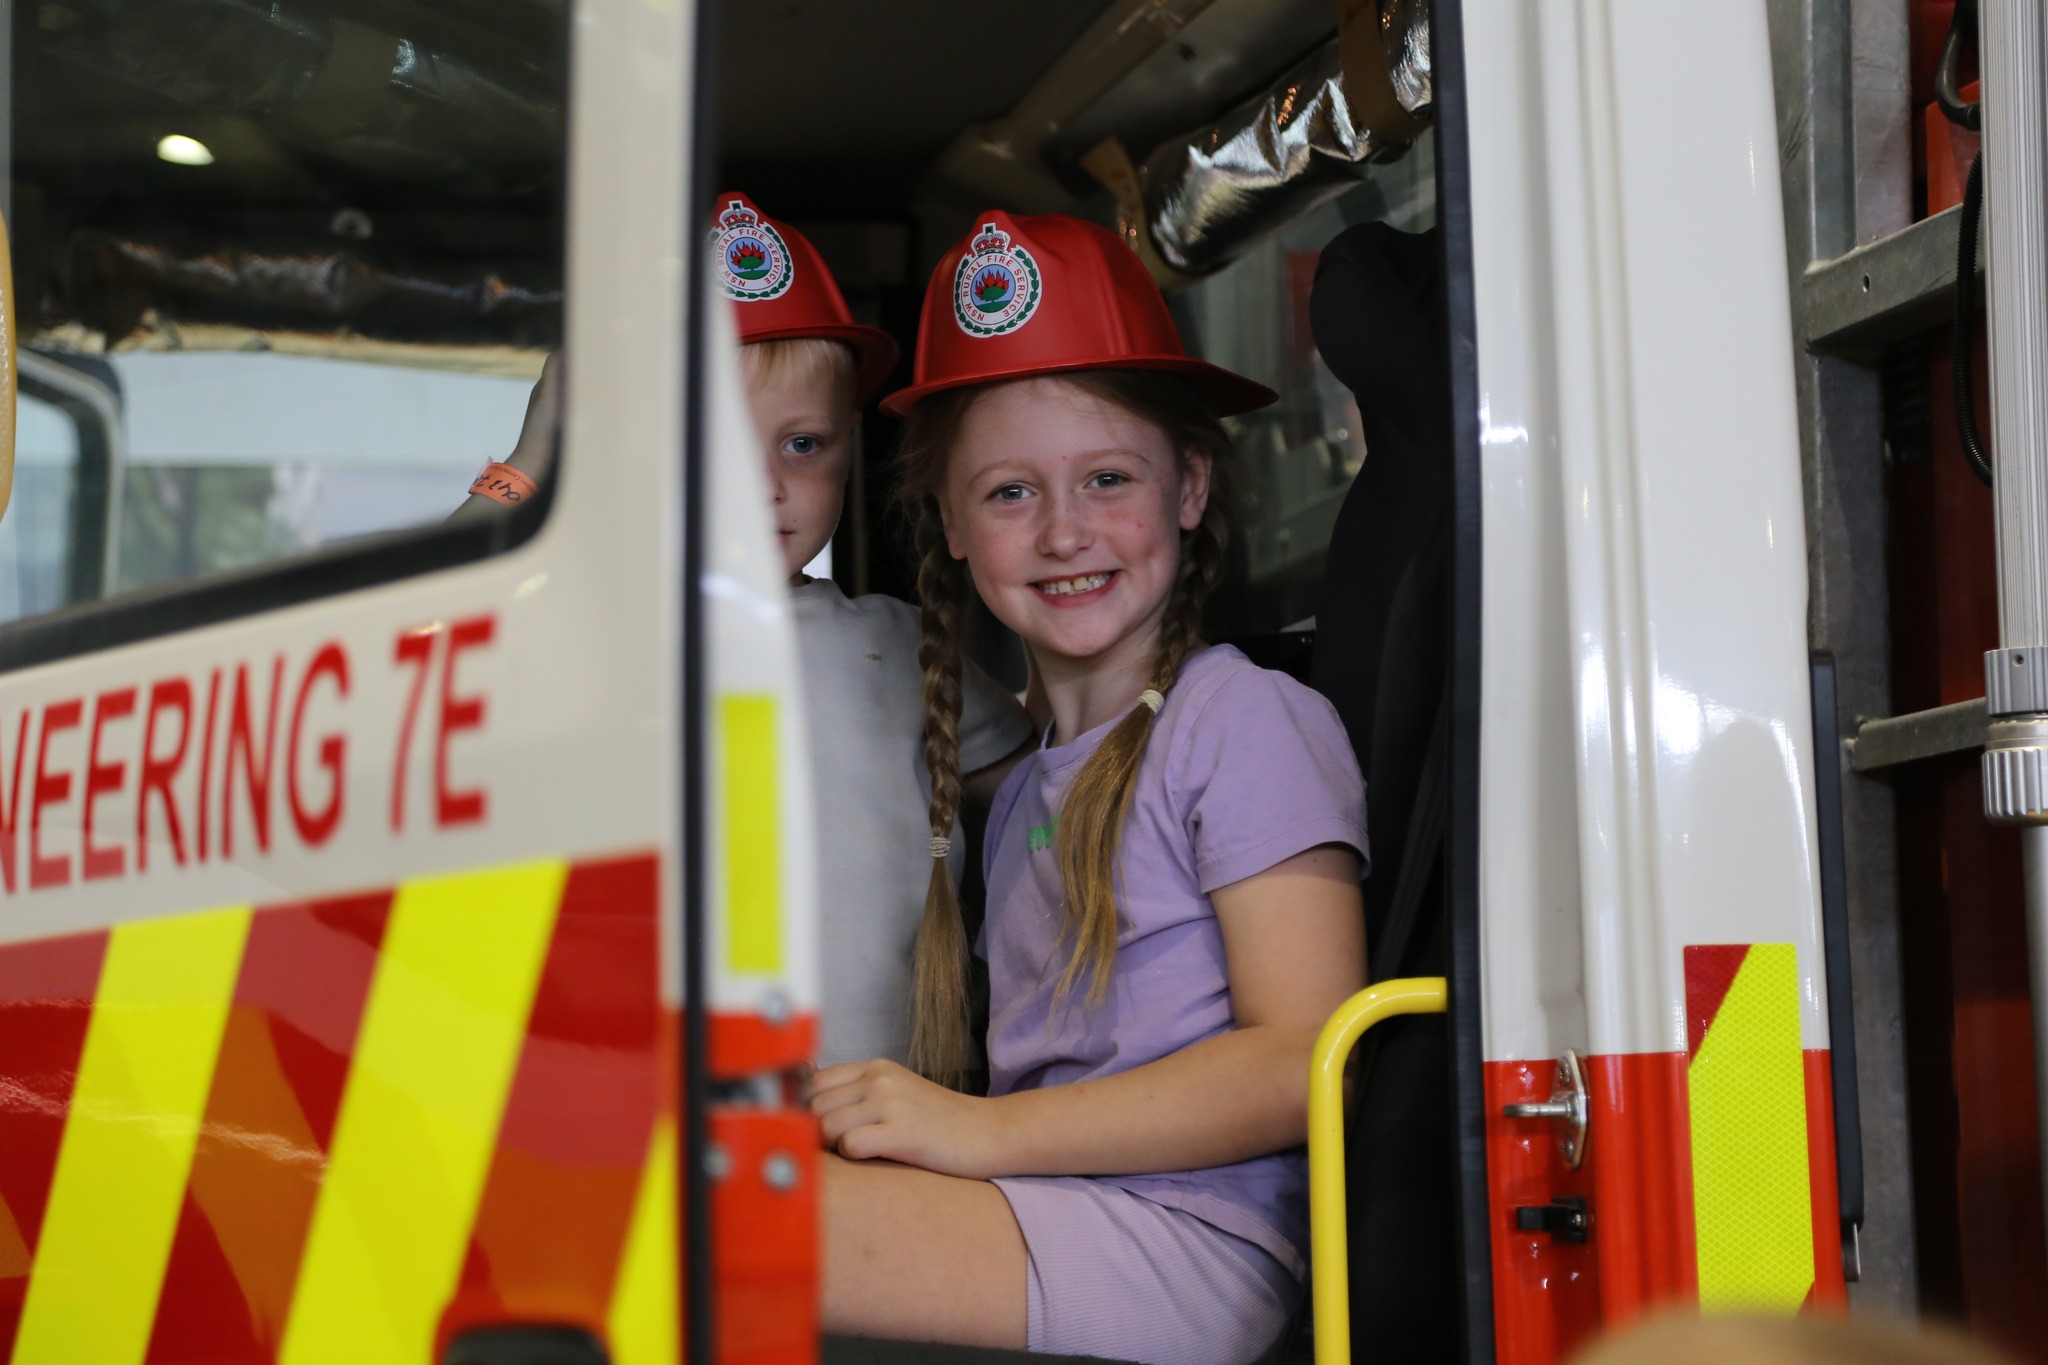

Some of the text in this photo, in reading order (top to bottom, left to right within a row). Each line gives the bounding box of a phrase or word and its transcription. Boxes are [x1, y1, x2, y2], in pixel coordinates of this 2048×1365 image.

[716, 229, 780, 287] NSW RURAL FIRE SERVICE
[963, 255, 1026, 321] NSW RURAL FIRE SERVICE
[391, 613, 497, 834] 7E
